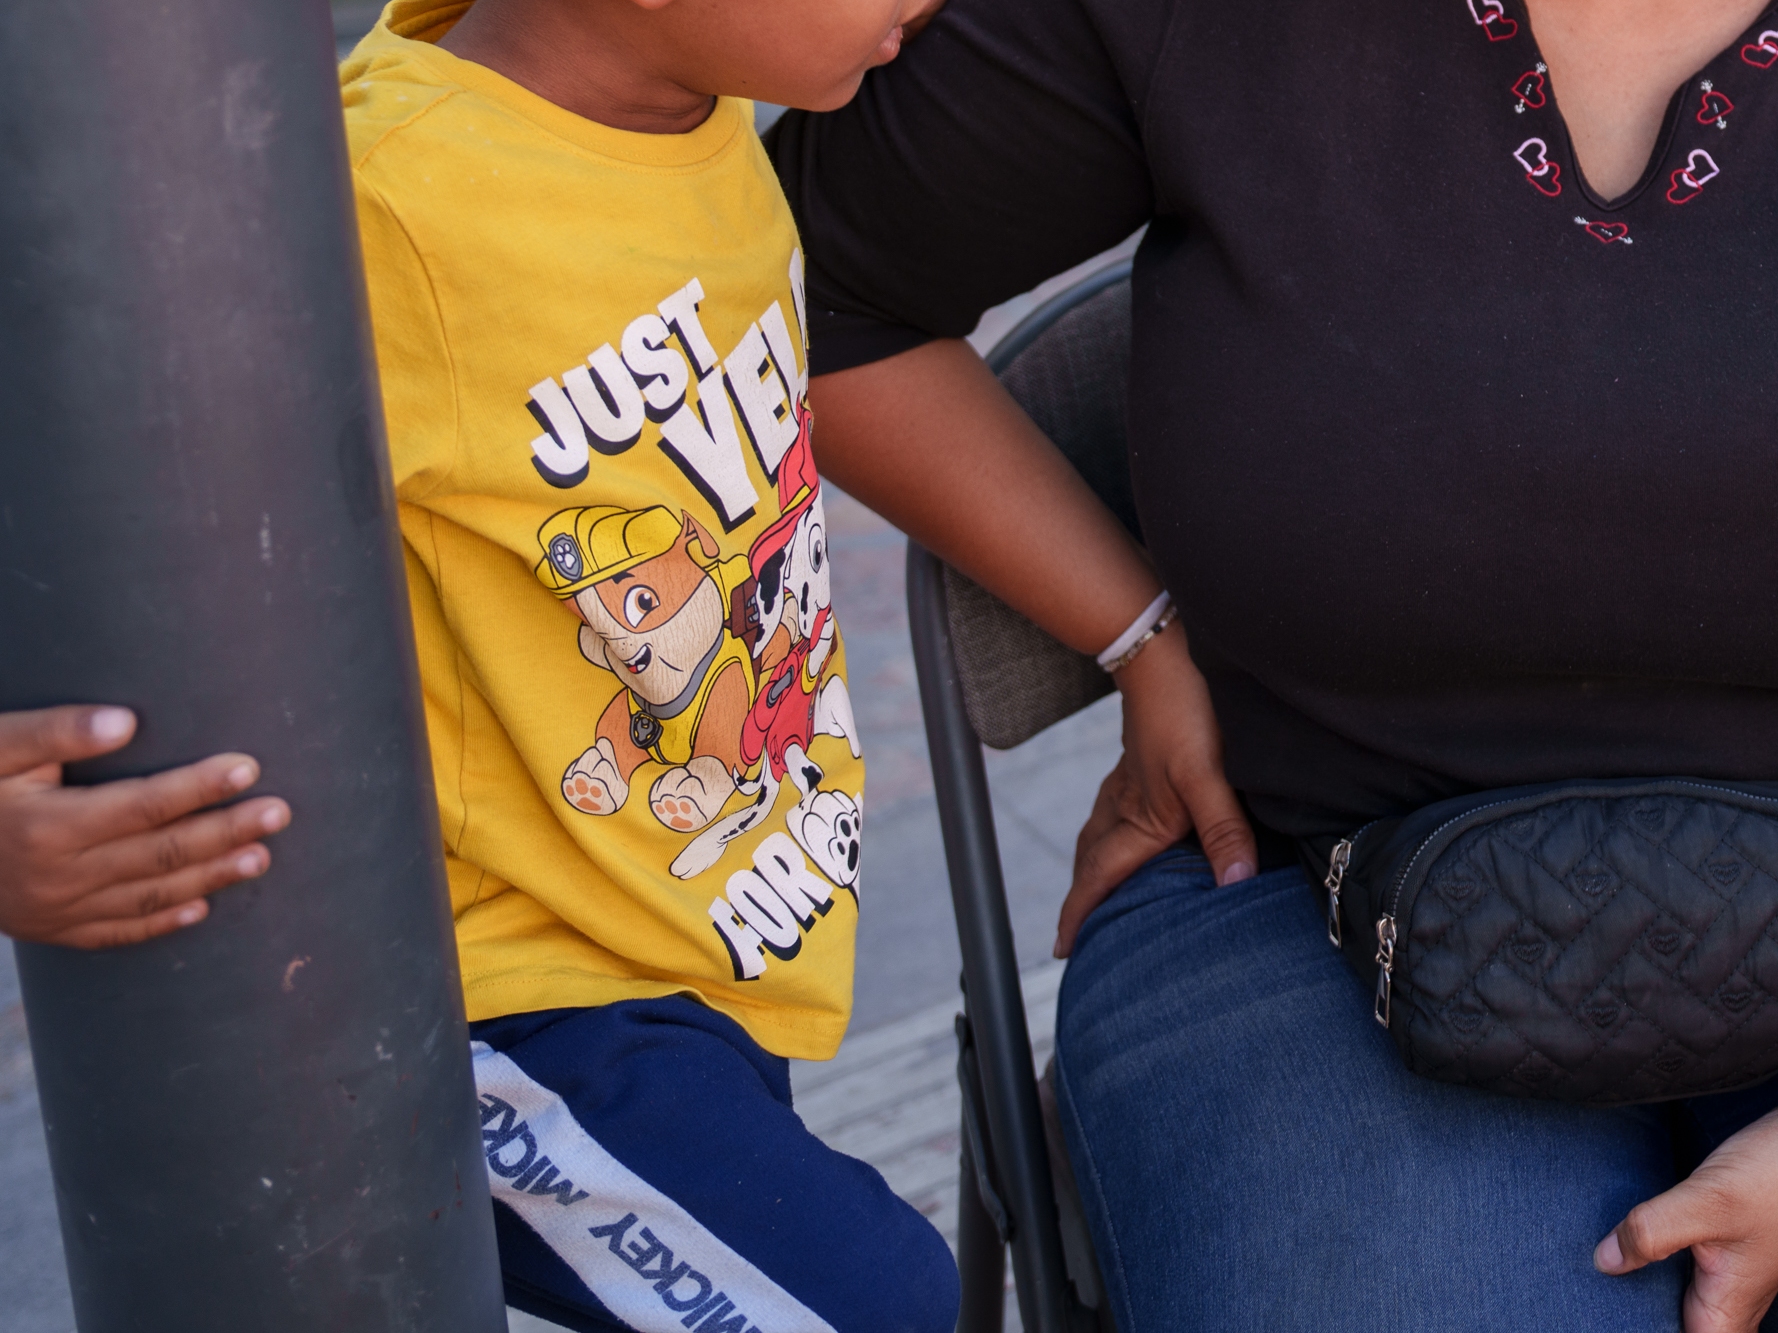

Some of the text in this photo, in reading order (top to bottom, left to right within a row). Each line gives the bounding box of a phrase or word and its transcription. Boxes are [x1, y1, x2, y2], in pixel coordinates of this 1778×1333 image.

[525, 276, 719, 489] JUST
[707, 831, 835, 982] FOR
[479, 1092, 763, 1333] MICKE MICKEY
